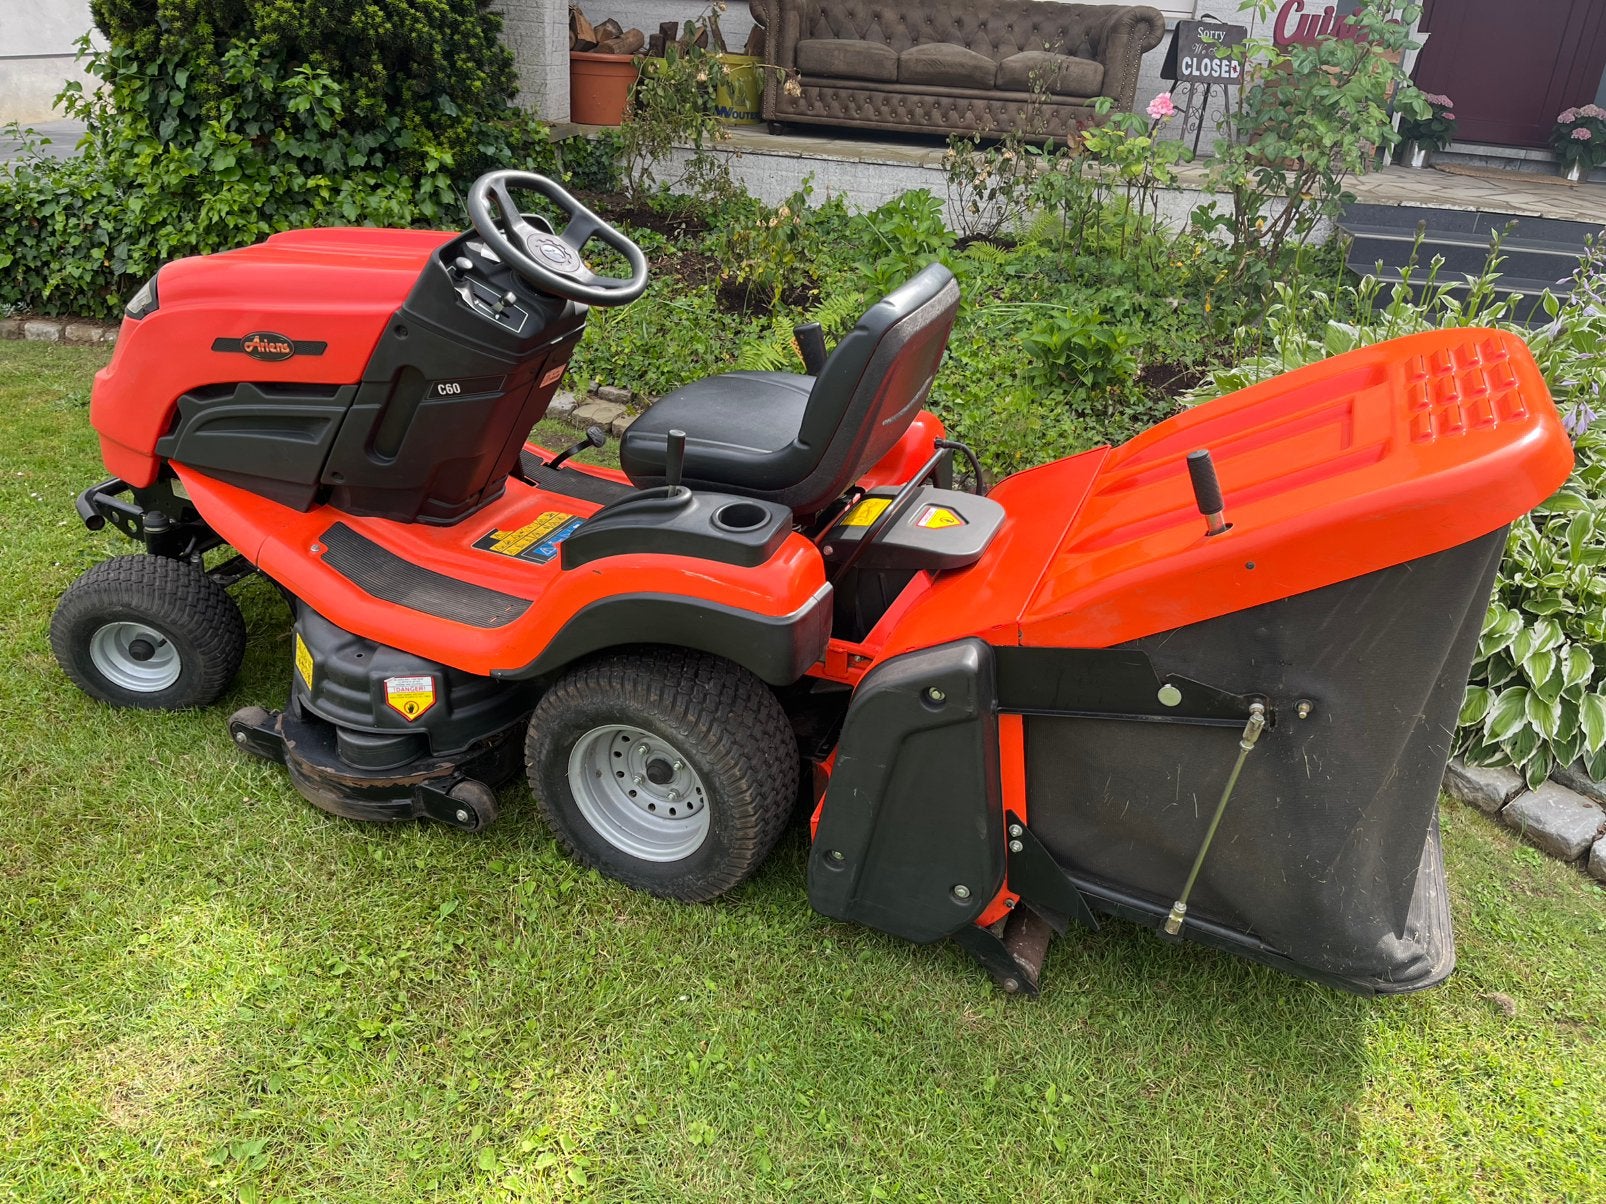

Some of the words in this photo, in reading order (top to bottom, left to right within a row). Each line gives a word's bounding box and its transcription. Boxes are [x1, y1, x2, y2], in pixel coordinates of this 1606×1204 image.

[1197, 26, 1226, 42] Sorry
[1181, 56, 1240, 78] CLOSED
[244, 336, 290, 353] Ariens
[437, 383, 461, 396] C60
